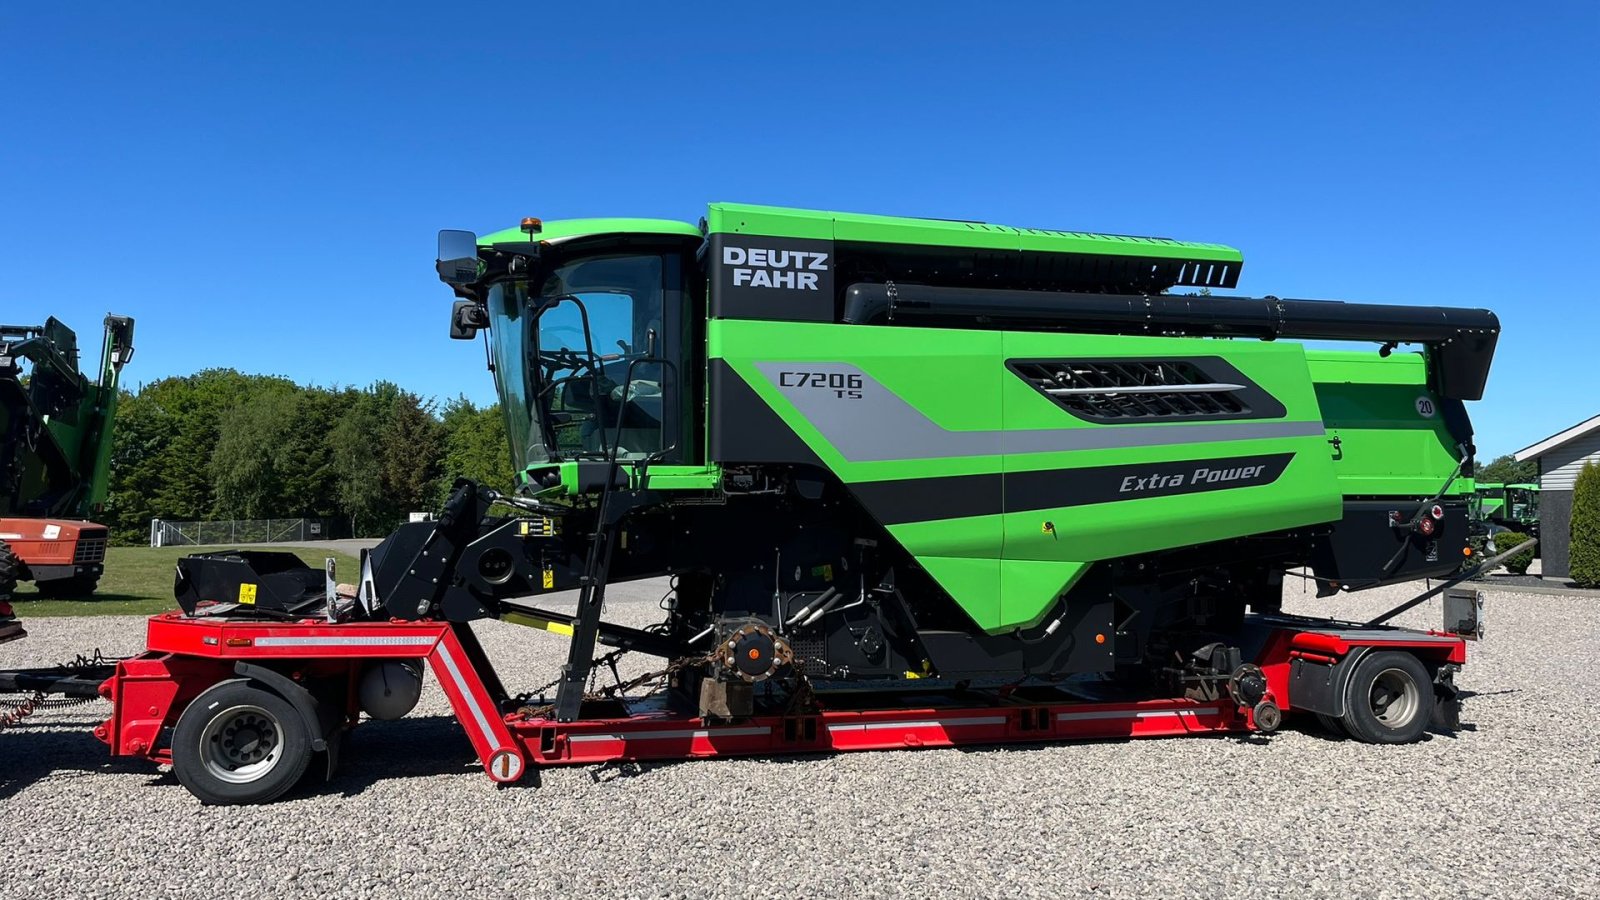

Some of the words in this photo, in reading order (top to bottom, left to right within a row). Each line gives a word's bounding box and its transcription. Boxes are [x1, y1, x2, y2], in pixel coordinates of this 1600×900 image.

[723, 246, 828, 271] DEUTZ
[733, 268, 819, 290] FAHR
[779, 371, 863, 389] C7206
[834, 389, 862, 399] TS
[1418, 400, 1432, 414] 20
[1119, 473, 1184, 492] Extra
[1190, 465, 1265, 485] Power
